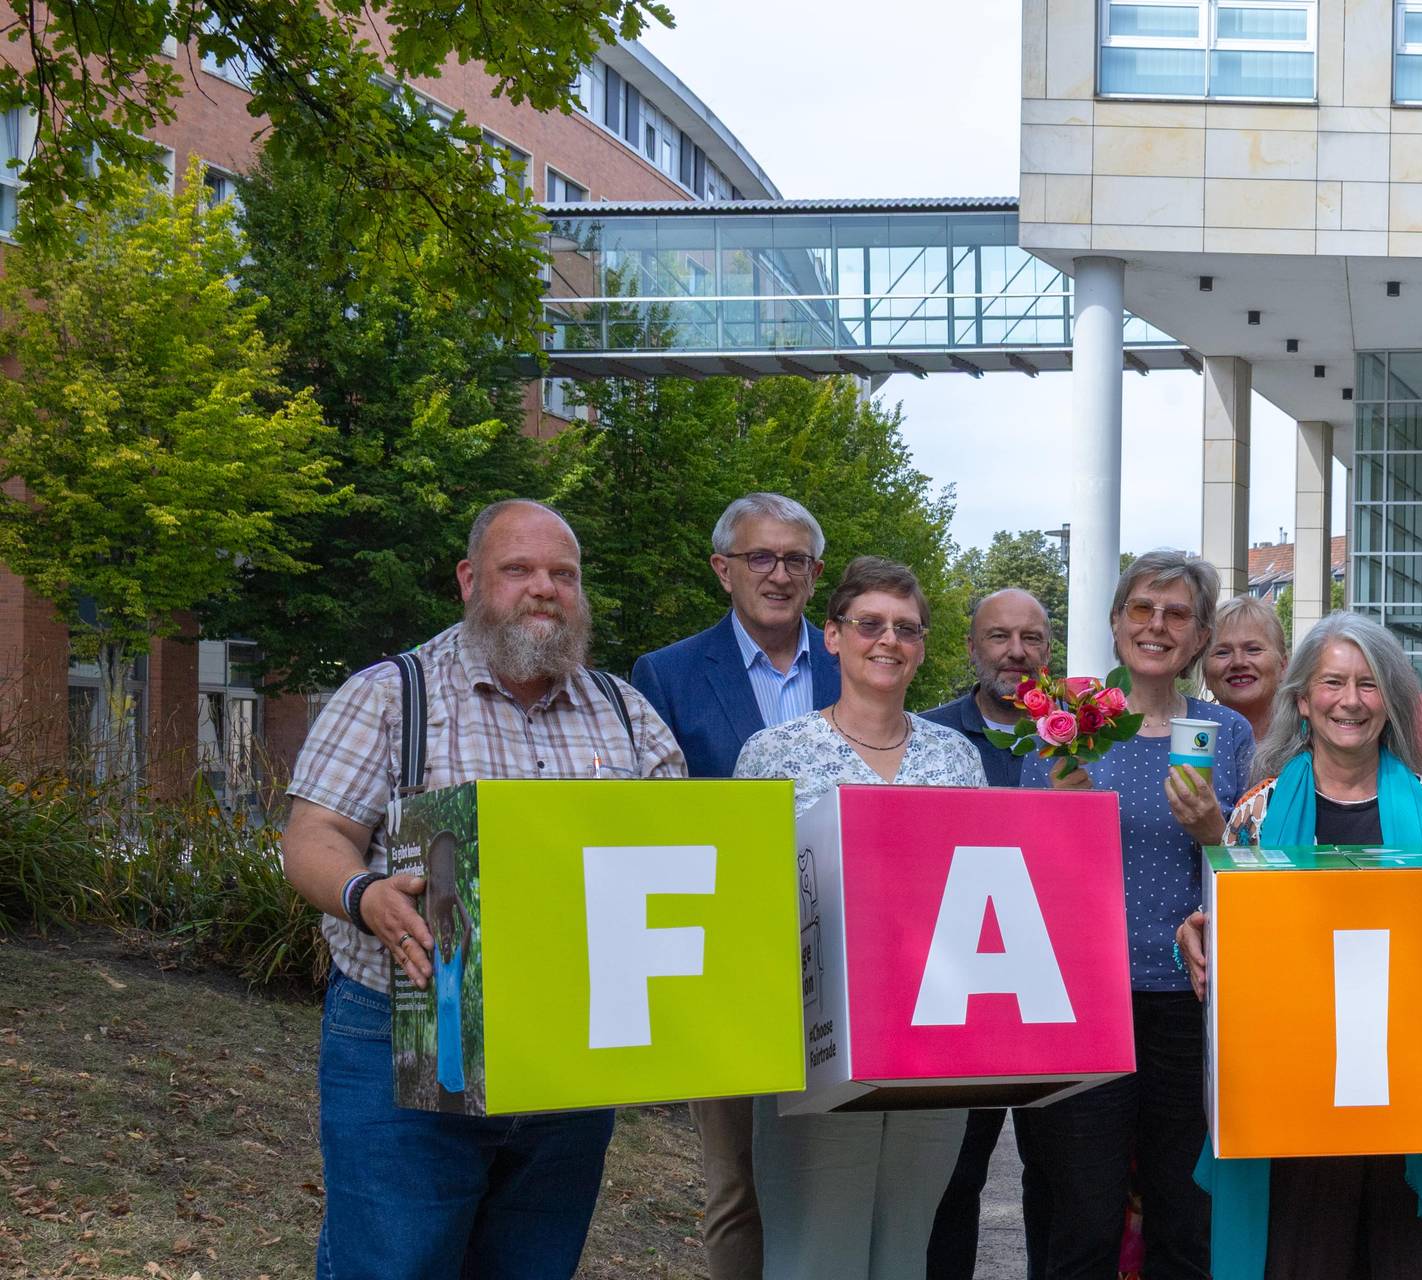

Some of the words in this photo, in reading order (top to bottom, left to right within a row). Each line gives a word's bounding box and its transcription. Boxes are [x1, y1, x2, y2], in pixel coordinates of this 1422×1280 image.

[582, 844, 718, 1049] F
[911, 845, 1077, 1026] A
[1333, 929, 1390, 1107] I
[810, 1038, 837, 1069] Fairtrade
